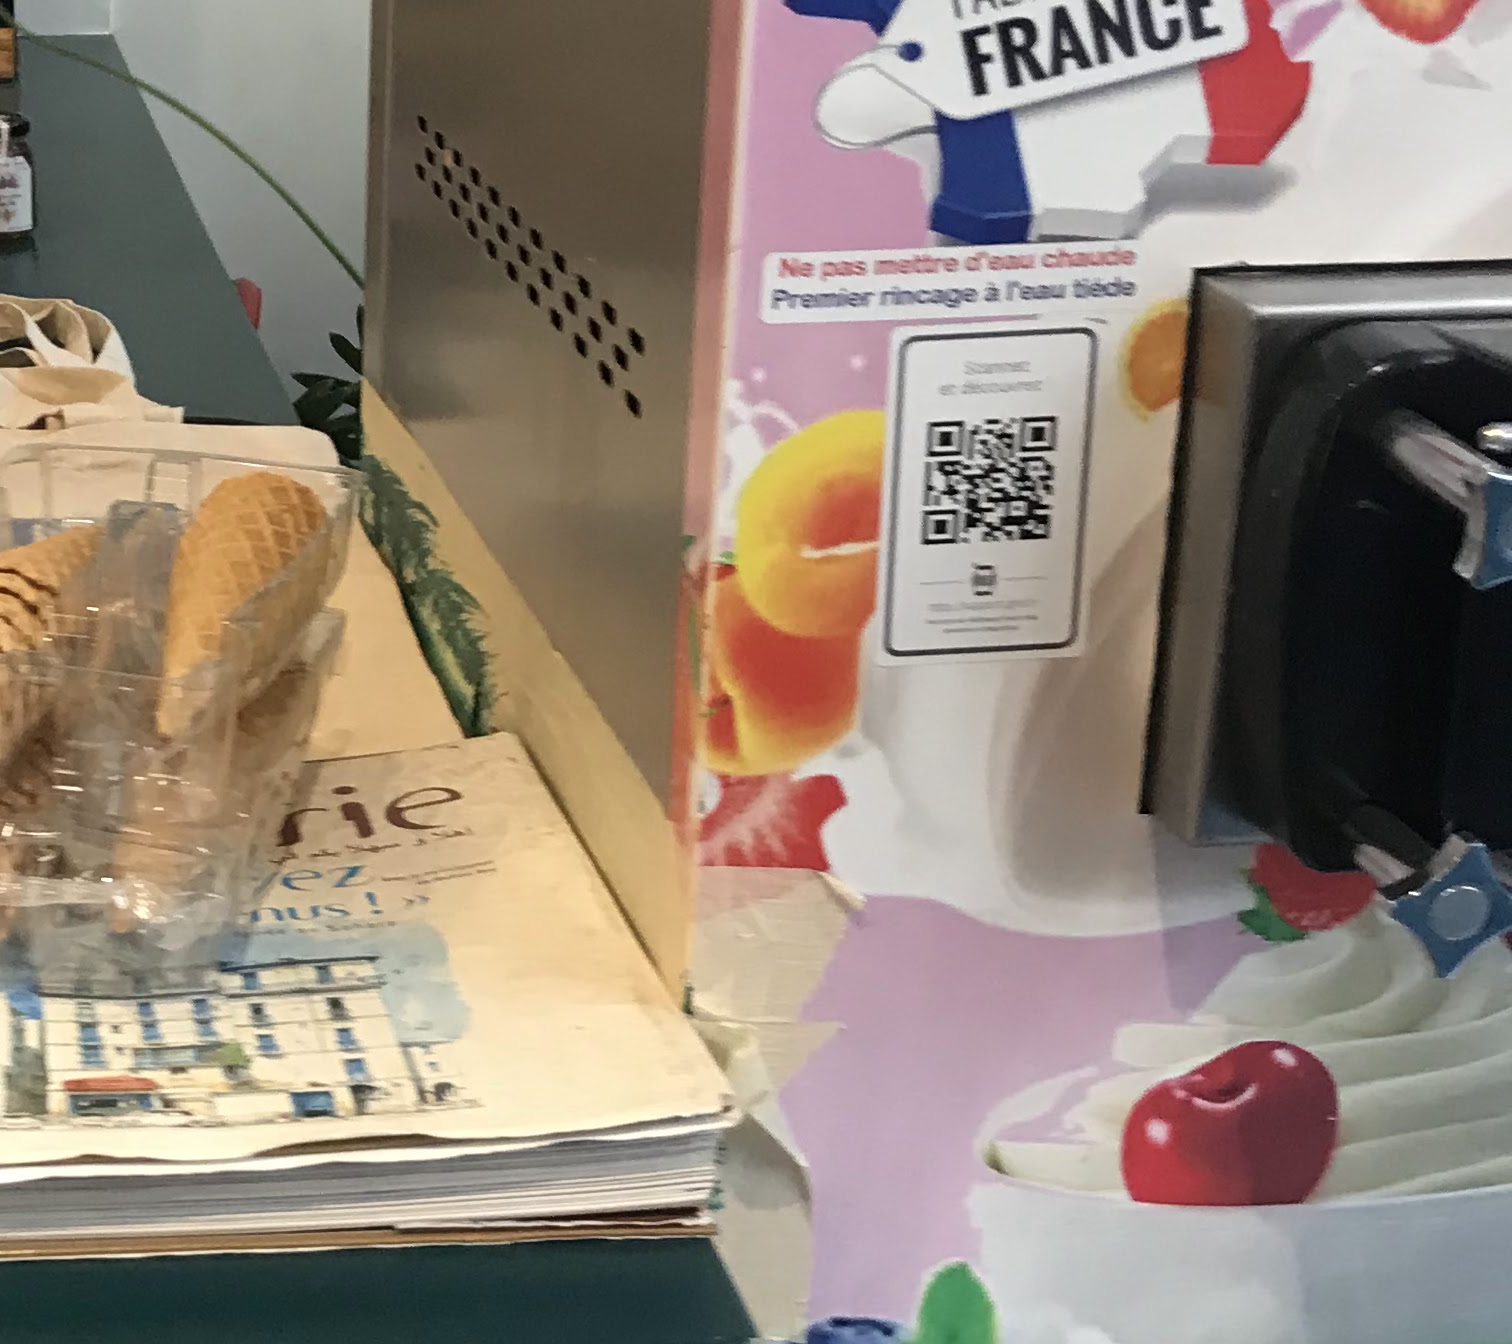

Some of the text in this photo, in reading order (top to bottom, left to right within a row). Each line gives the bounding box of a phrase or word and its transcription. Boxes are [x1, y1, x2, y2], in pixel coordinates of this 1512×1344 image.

[778, 247, 1137, 281] Ne pas mettre d'eau chaude
[772, 287, 873, 309] Premier
[983, 281, 1000, 302] à
[1005, 280, 1066, 302] l'eau
